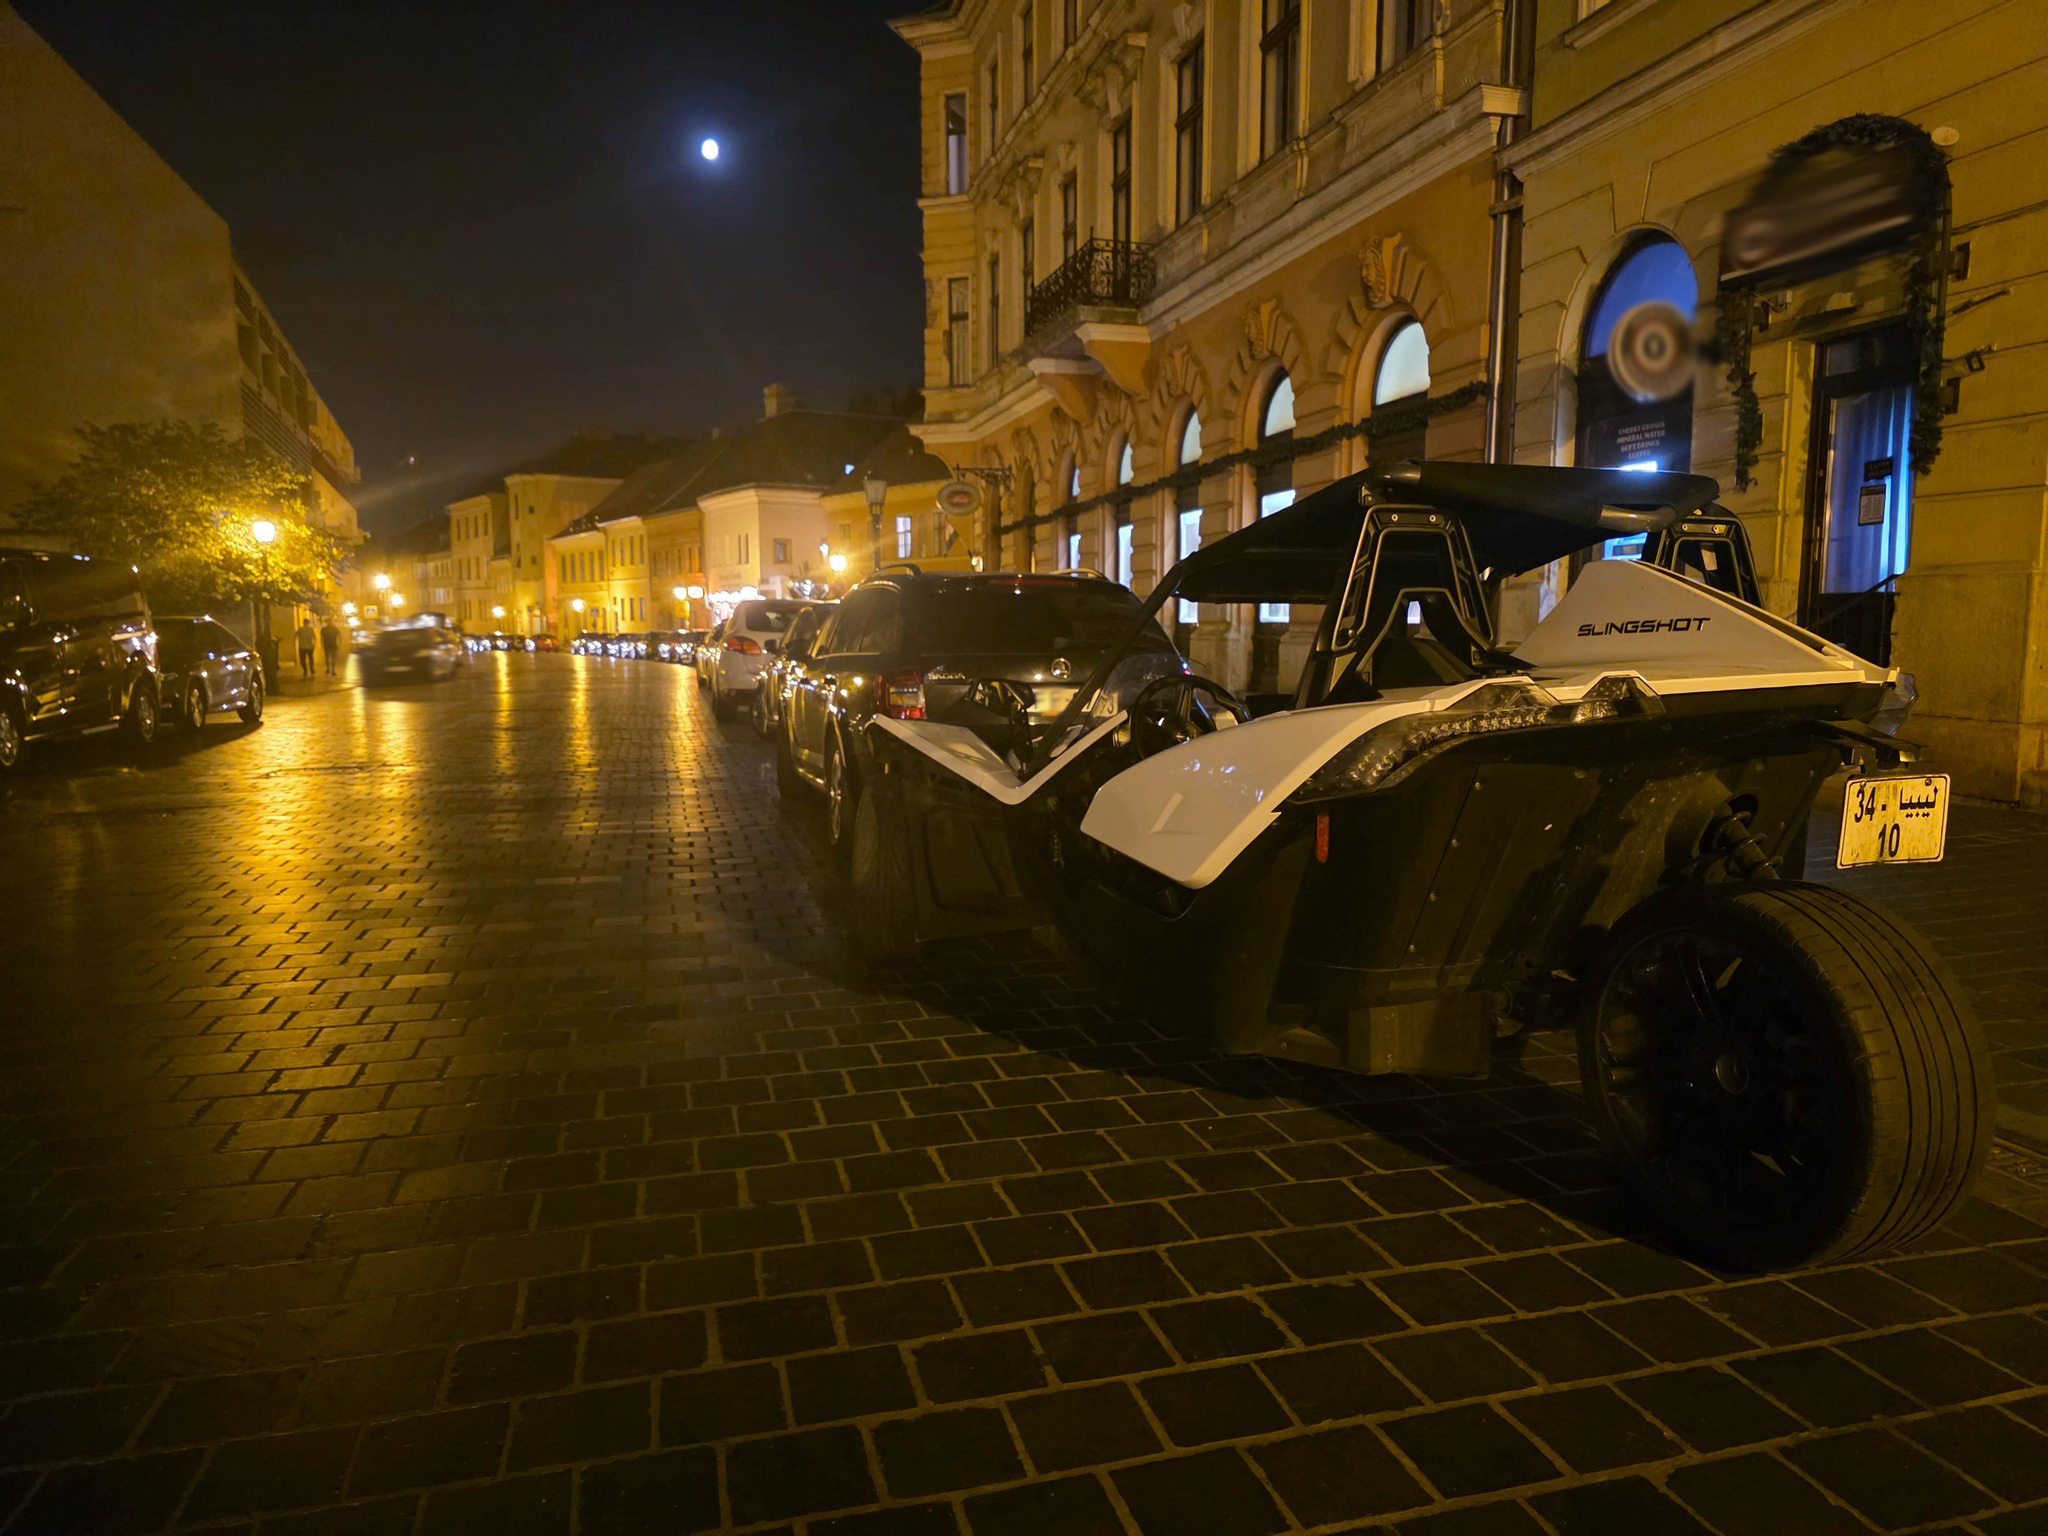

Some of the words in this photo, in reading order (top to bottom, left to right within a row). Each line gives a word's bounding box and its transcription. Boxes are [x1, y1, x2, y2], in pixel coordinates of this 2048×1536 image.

[1616, 432, 1643, 444] MINERAL
[1644, 430, 1665, 439] WATER
[1620, 443, 1636, 453] SOFT
[1637, 439, 1660, 449] DRINKS
[1578, 618, 1710, 637] SLINGSHOT
[1854, 786, 1876, 823] 34
[1899, 786, 1938, 818] ليبيا
[1878, 823, 1900, 858] 10
